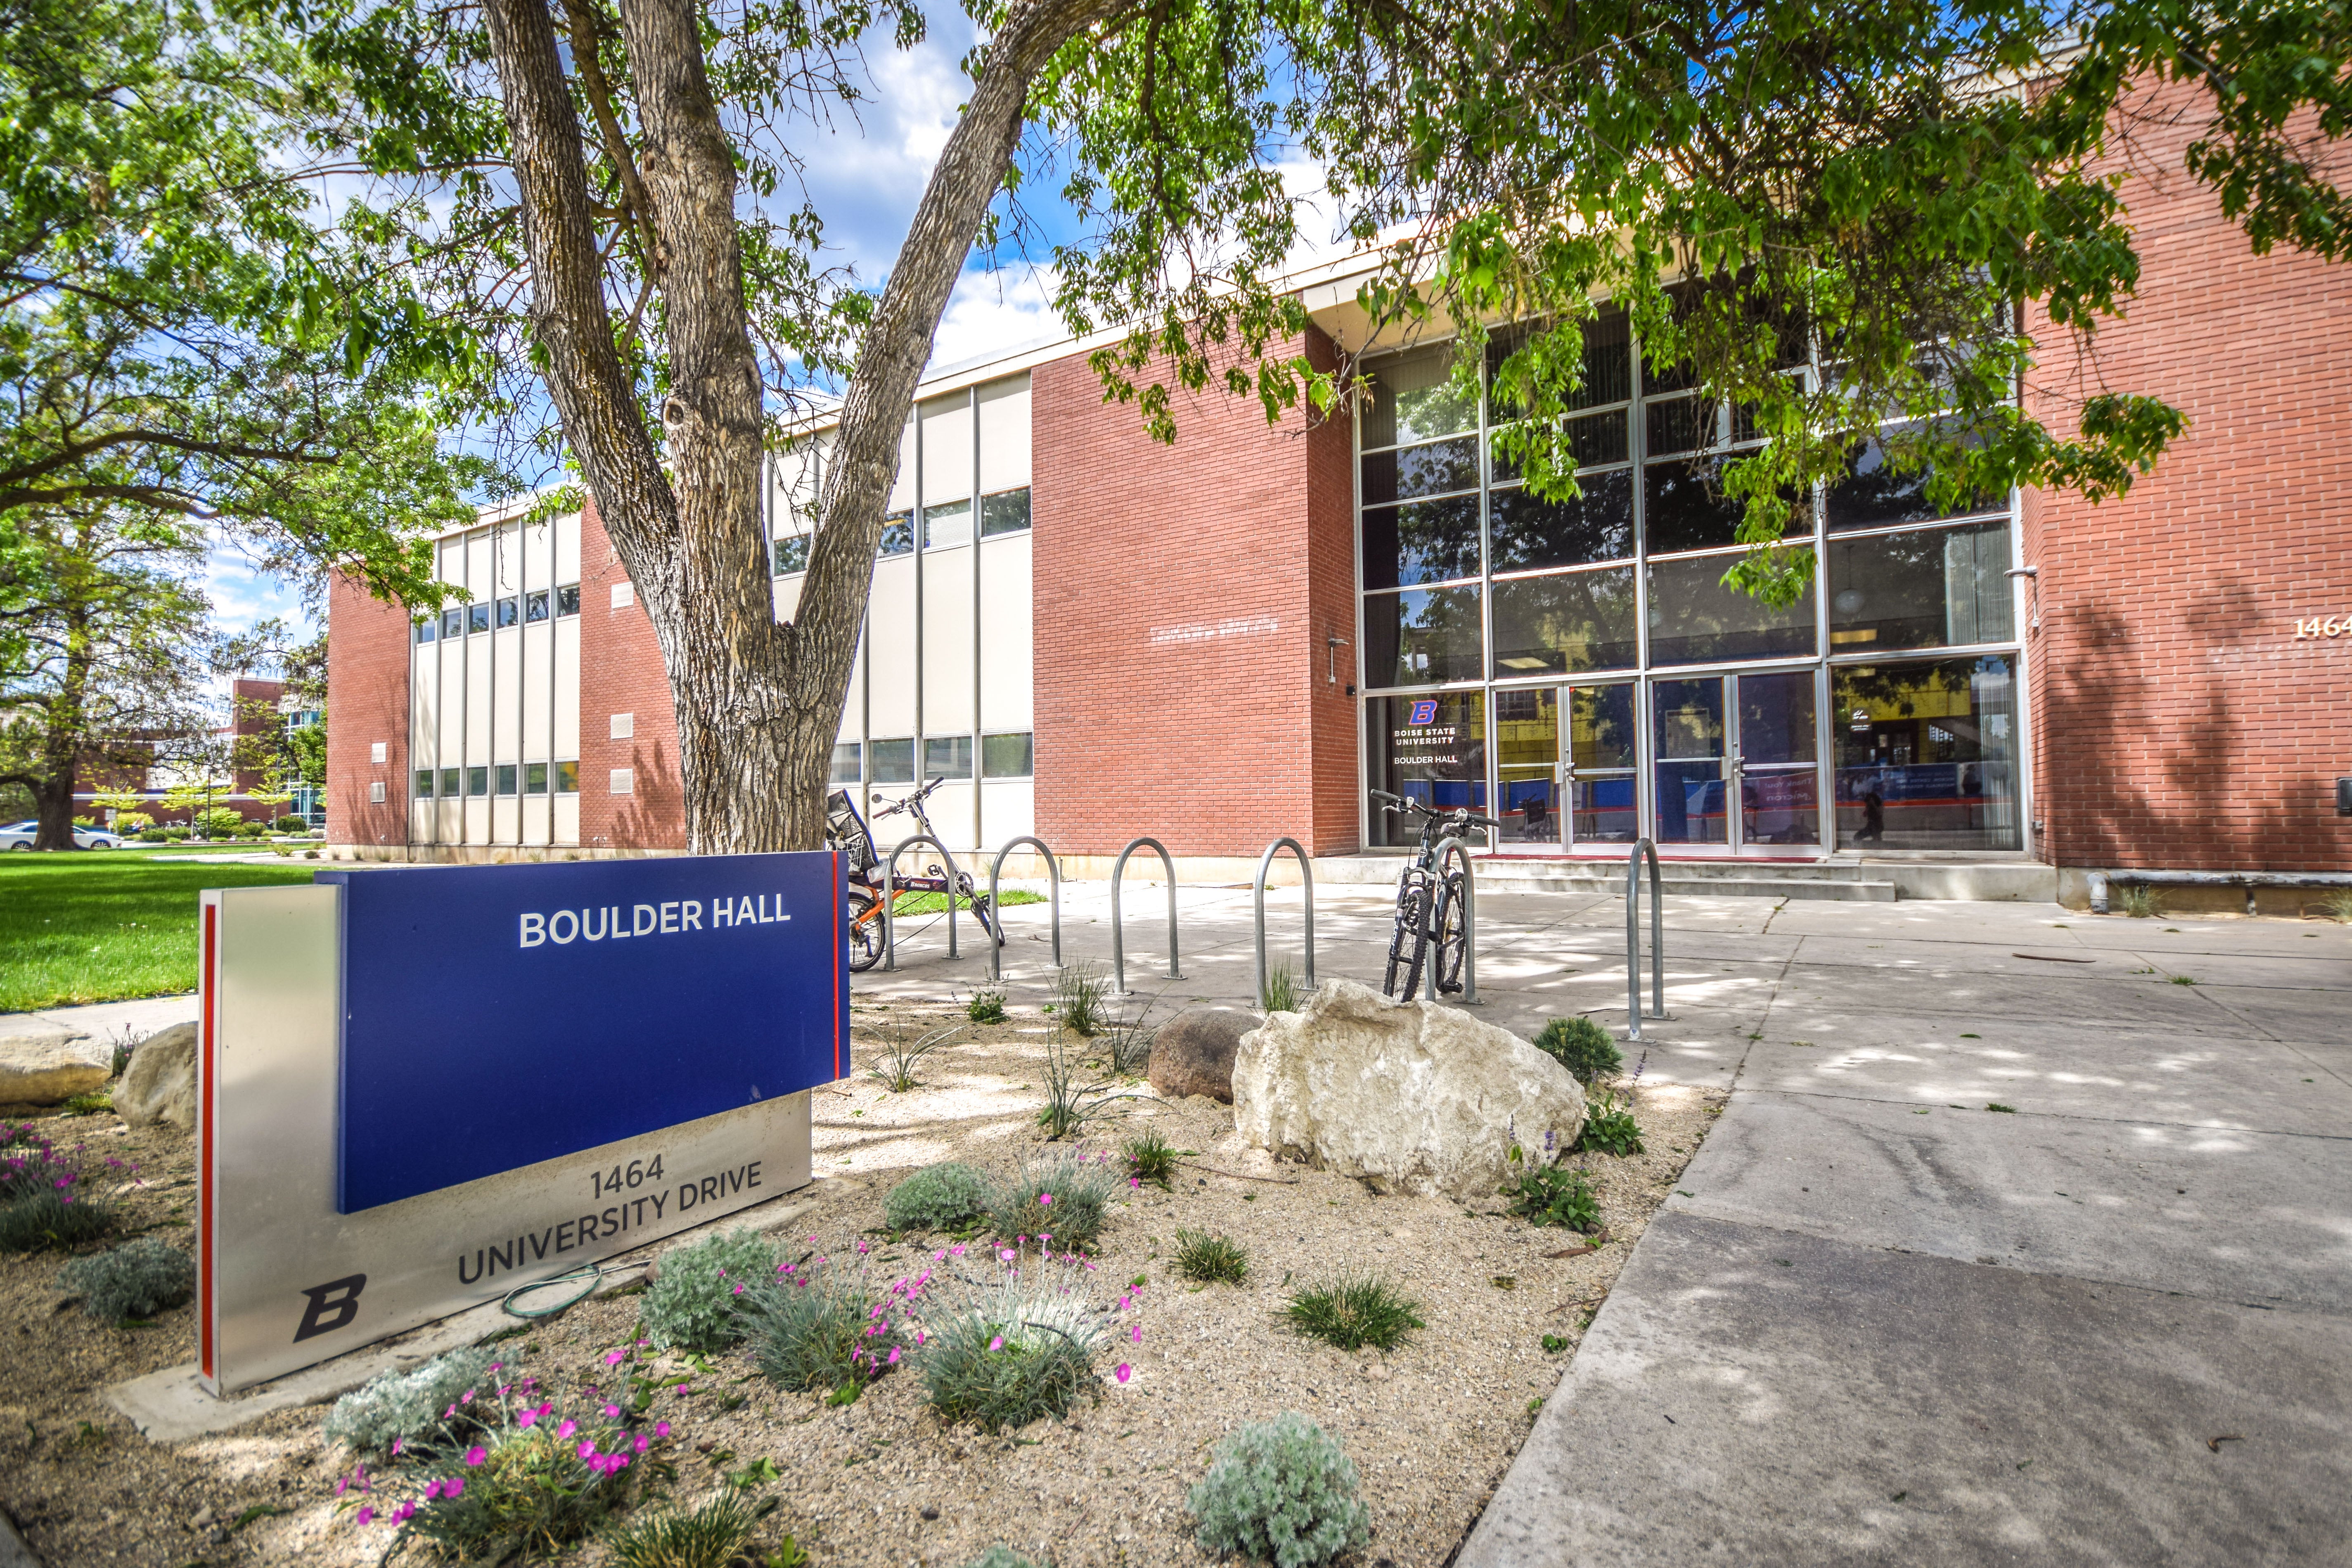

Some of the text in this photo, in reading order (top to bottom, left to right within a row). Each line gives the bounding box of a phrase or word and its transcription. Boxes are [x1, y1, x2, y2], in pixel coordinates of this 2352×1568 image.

[2293, 615, 2352, 638] 1464
[1409, 700, 1438, 725] B
[1396, 737, 1454, 746] UNIVERSITY
[1426, 727, 1456, 735] STATE
[1394, 755, 1458, 765] BOULDER HALL
[519, 893, 791, 948] BOULDER HALL
[590, 1153, 665, 1200] 1464
[458, 1160, 762, 1286] UNIVERSITY DRIVE
[292, 1273, 367, 1344] B
